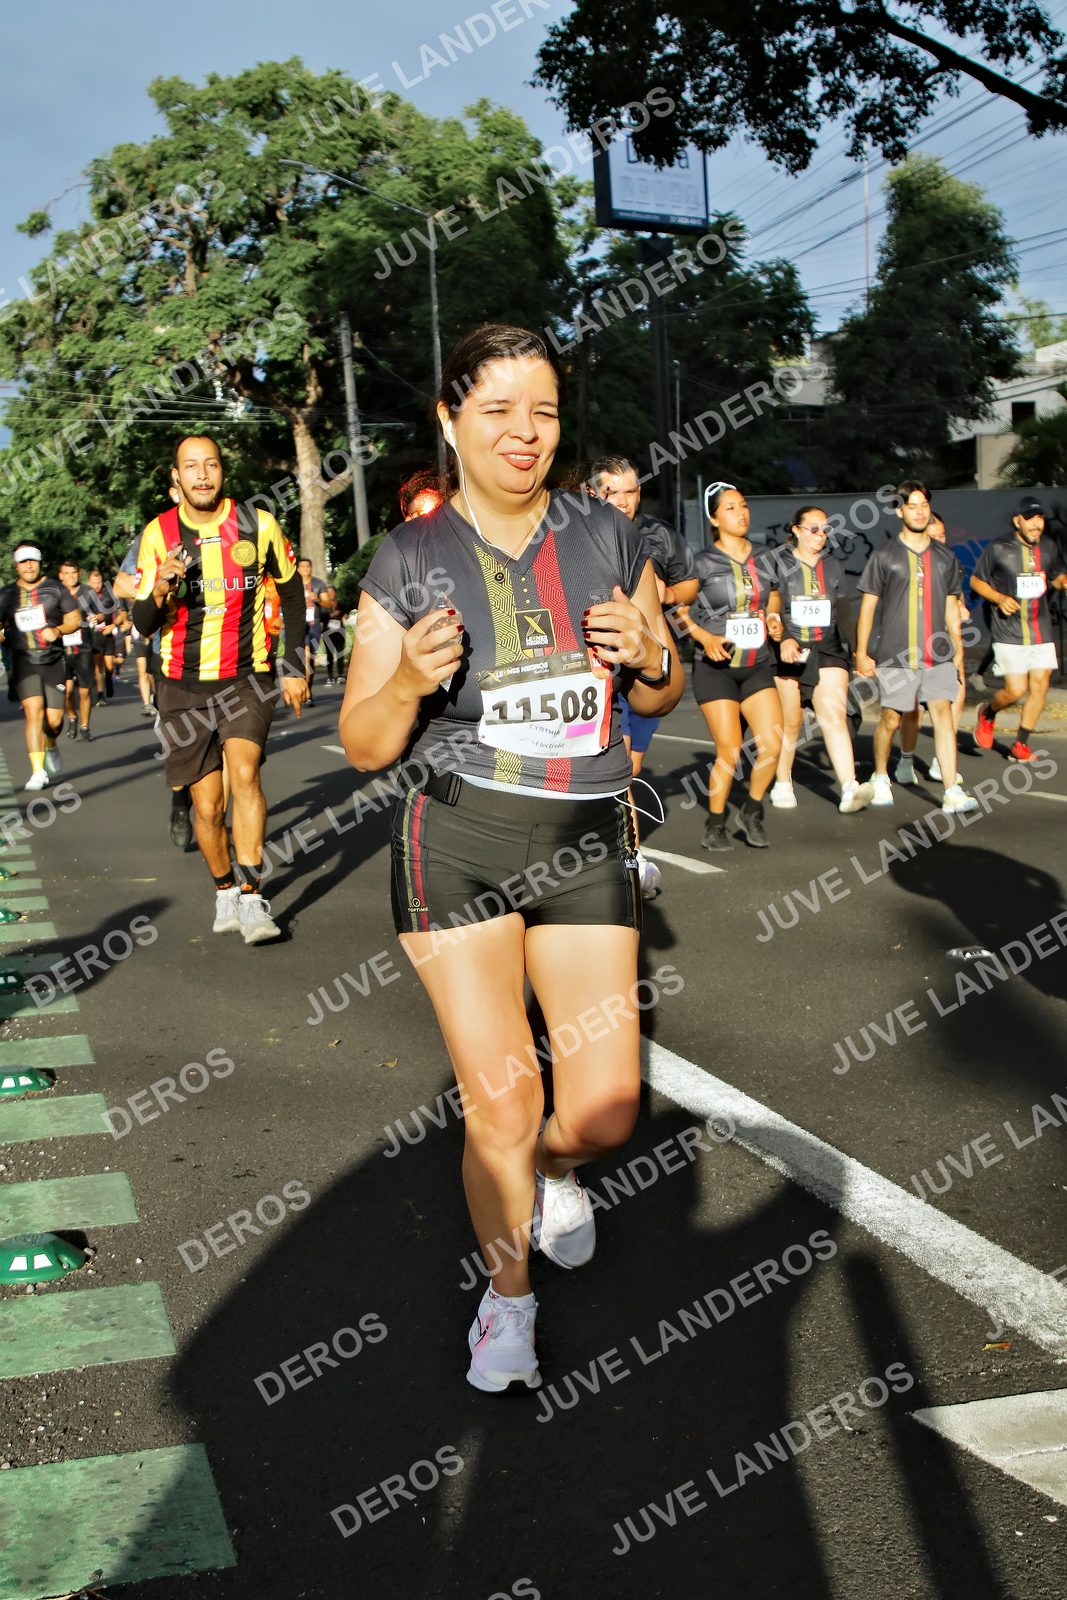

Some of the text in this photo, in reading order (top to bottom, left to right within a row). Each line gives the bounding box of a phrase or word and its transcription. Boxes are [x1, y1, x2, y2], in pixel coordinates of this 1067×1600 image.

[802, 605, 820, 615] 756
[732, 623, 759, 635] 9163
[491, 686, 598, 724] 11508
